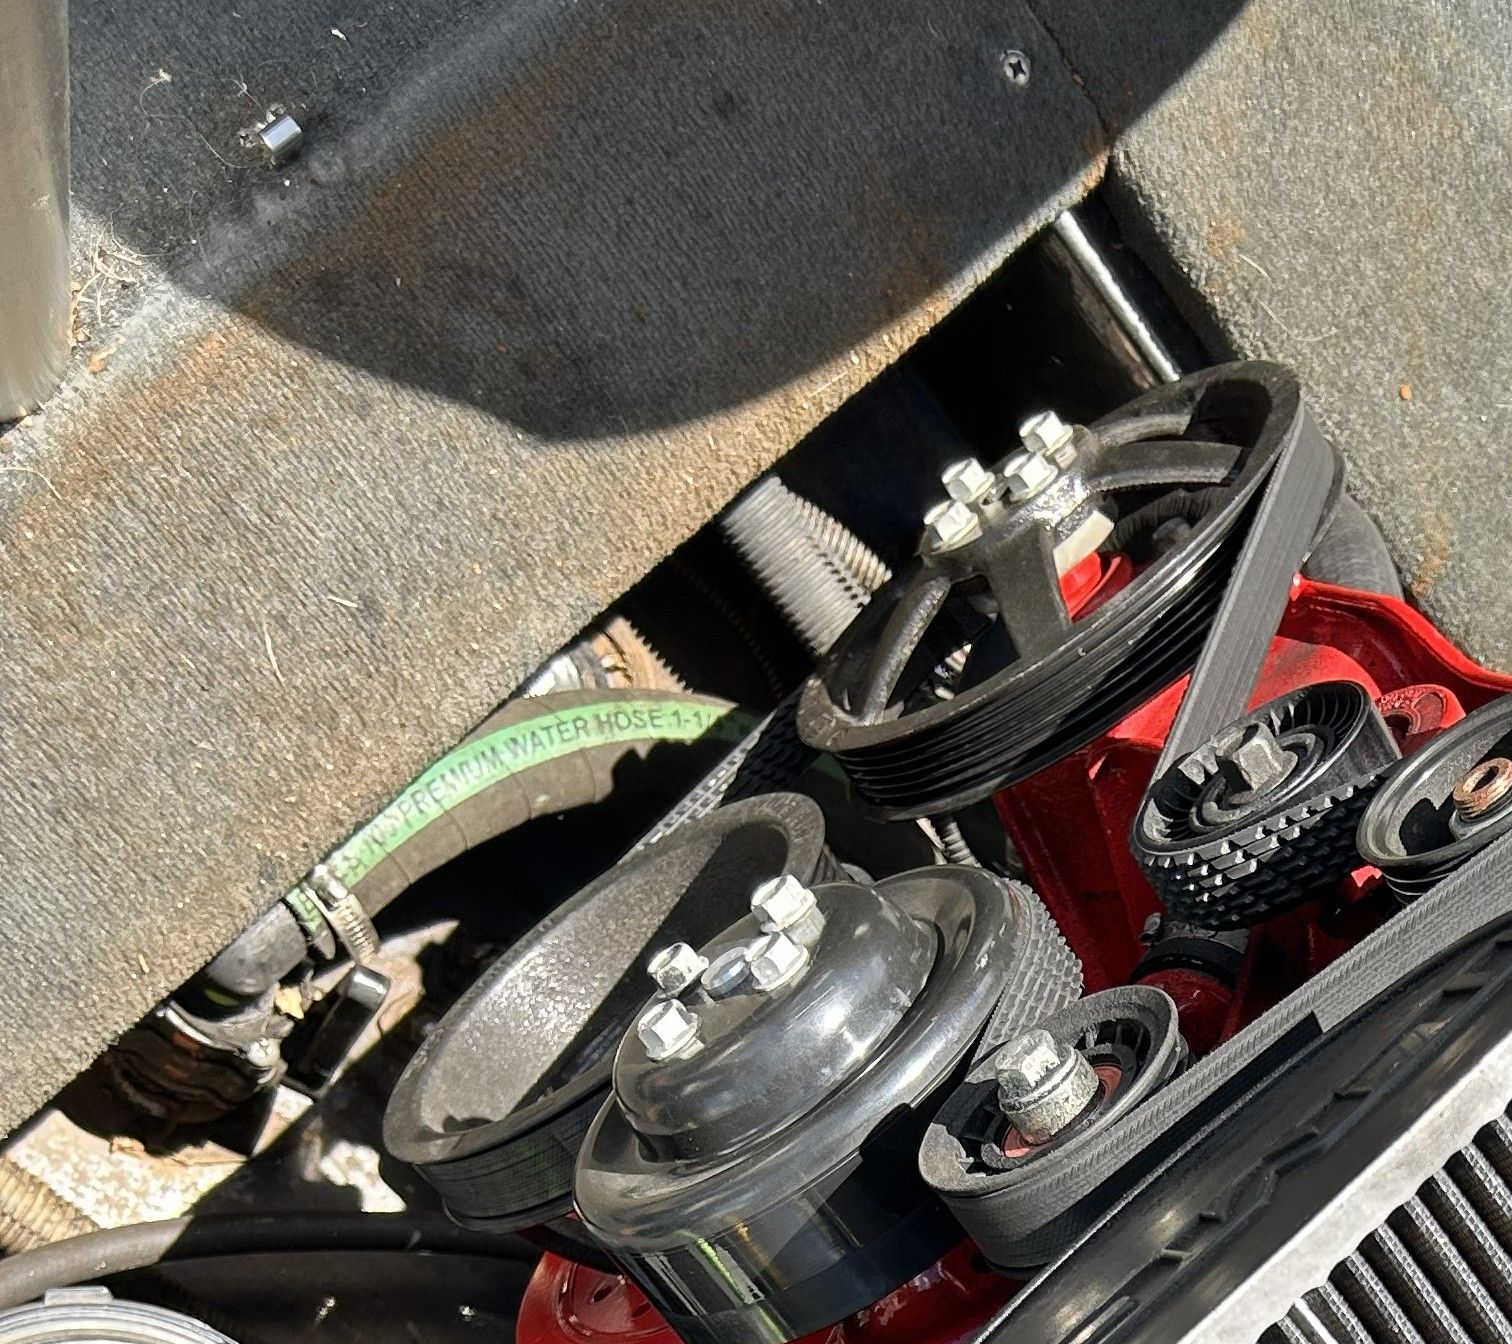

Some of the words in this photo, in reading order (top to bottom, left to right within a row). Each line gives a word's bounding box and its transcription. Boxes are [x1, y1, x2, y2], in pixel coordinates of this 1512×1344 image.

[397, 744, 506, 829] PREMIUM
[504, 714, 590, 760] WATER
[594, 708, 664, 737] HOSE
